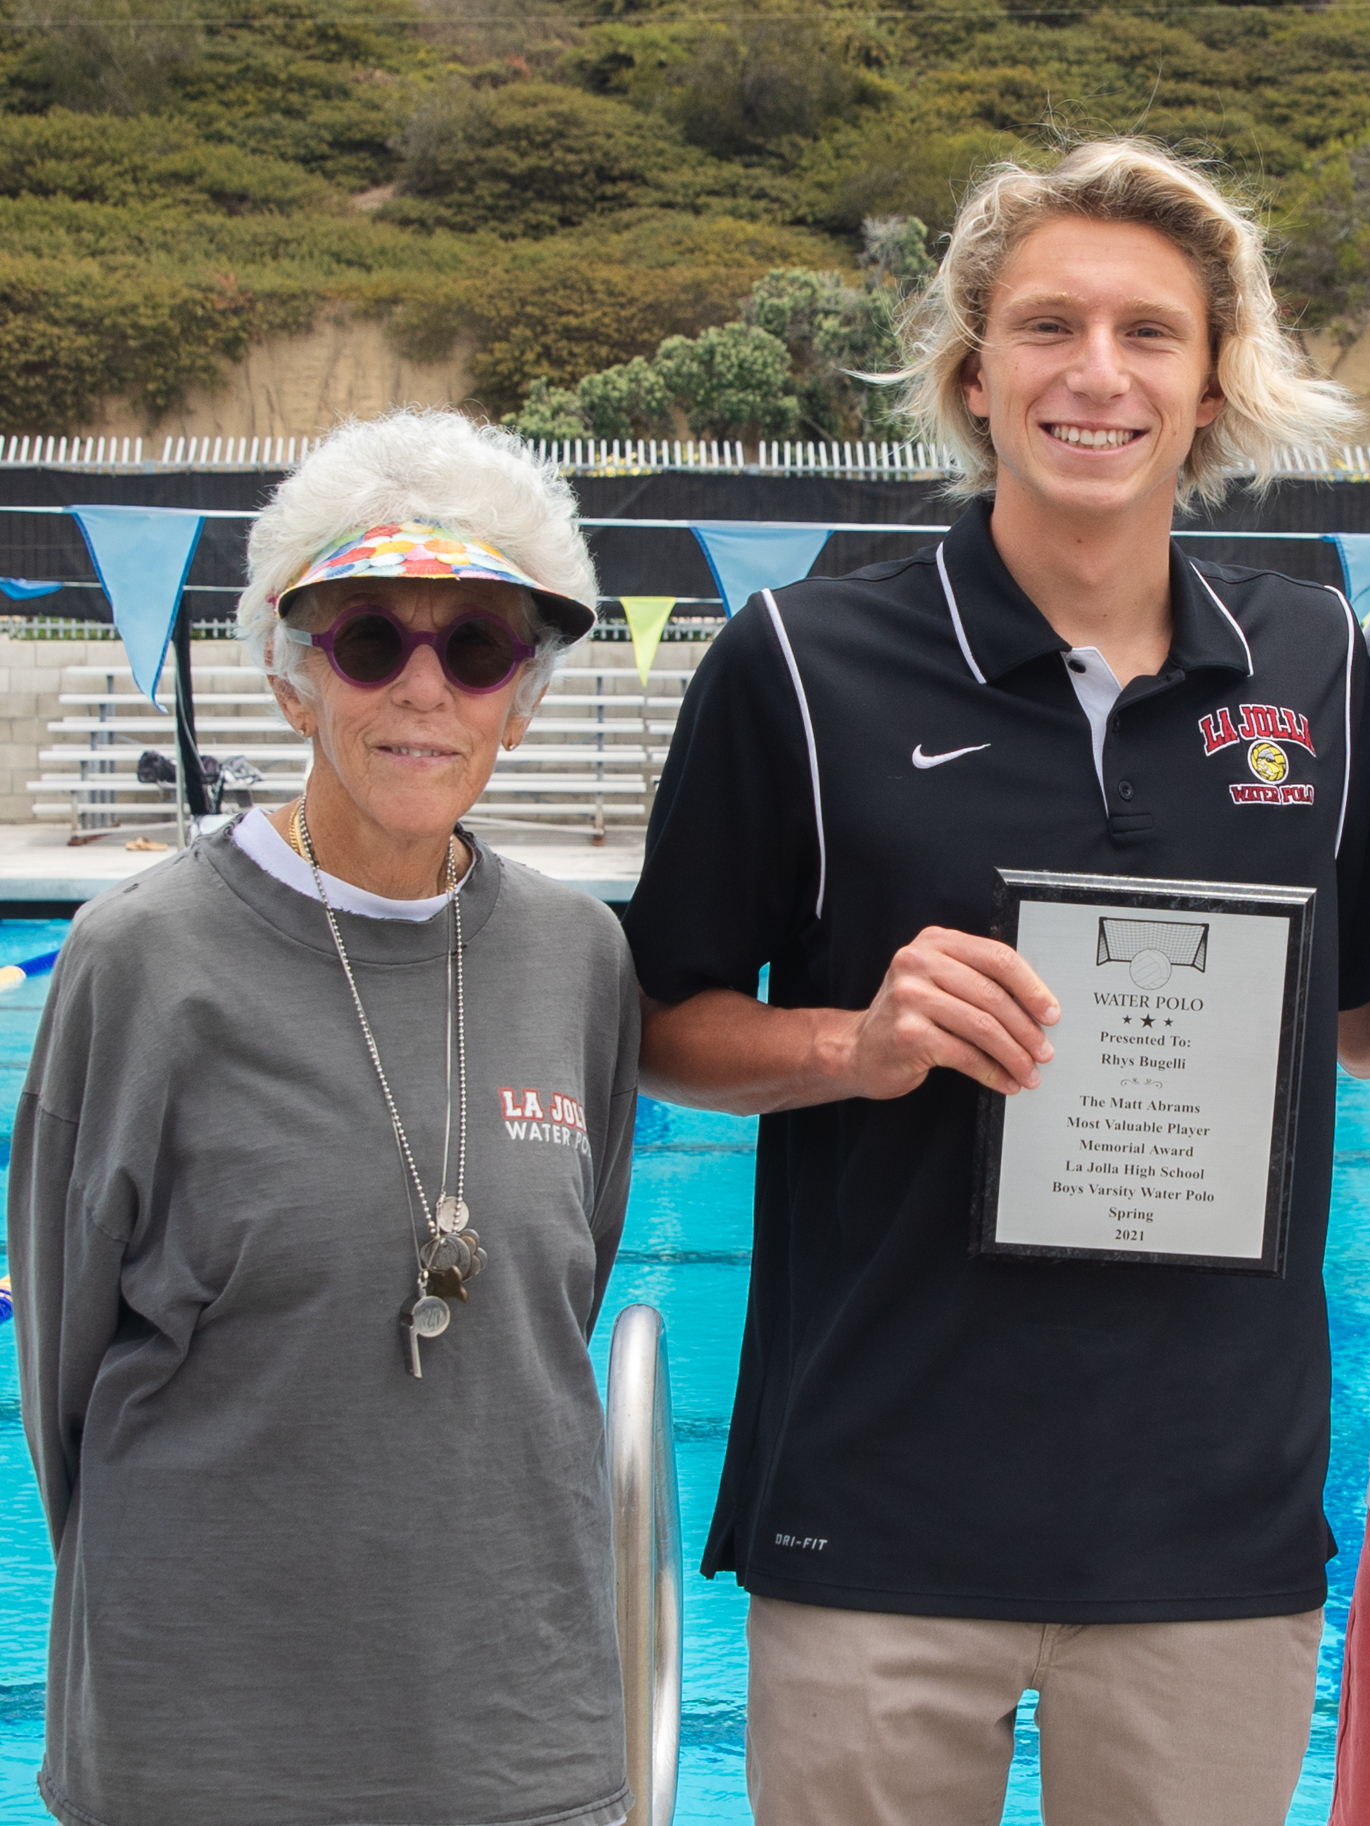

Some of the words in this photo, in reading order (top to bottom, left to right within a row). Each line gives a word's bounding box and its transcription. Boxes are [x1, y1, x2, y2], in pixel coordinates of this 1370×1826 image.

[1198, 707, 1240, 756] LA
[1238, 704, 1317, 758] JOLLA
[1229, 783, 1282, 805] WATER
[1093, 991, 1150, 1009] WATER
[1155, 995, 1204, 1012] POLO
[1100, 1031, 1166, 1047] Presented
[1169, 1035, 1191, 1048] To:
[1101, 1053, 1135, 1069] Rhys
[1139, 1055, 1186, 1071] Bugelli
[498, 1087, 545, 1120] LA
[1079, 1095, 1106, 1108] The
[1109, 1096, 1143, 1110] Matt
[1146, 1099, 1201, 1114] Abrams
[505, 1121, 570, 1146] WATER
[1066, 1116, 1100, 1130] Most
[1104, 1118, 1163, 1134] Valuable
[1167, 1122, 1211, 1138] Player
[1080, 1138, 1145, 1155] Memorial
[1149, 1144, 1194, 1158] Award
[1065, 1160, 1083, 1173] La
[1086, 1161, 1119, 1175] Jolla
[1123, 1163, 1156, 1179] High
[1159, 1166, 1205, 1180] School
[1052, 1181, 1084, 1197] Boys
[1088, 1183, 1136, 1201] Varsity
[1140, 1186, 1182, 1201] Water
[1185, 1189, 1215, 1203] Polo
[1108, 1206, 1154, 1224] Spring
[1114, 1228, 1144, 1242] 2021
[775, 1533, 828, 1551] DRI-FIT
